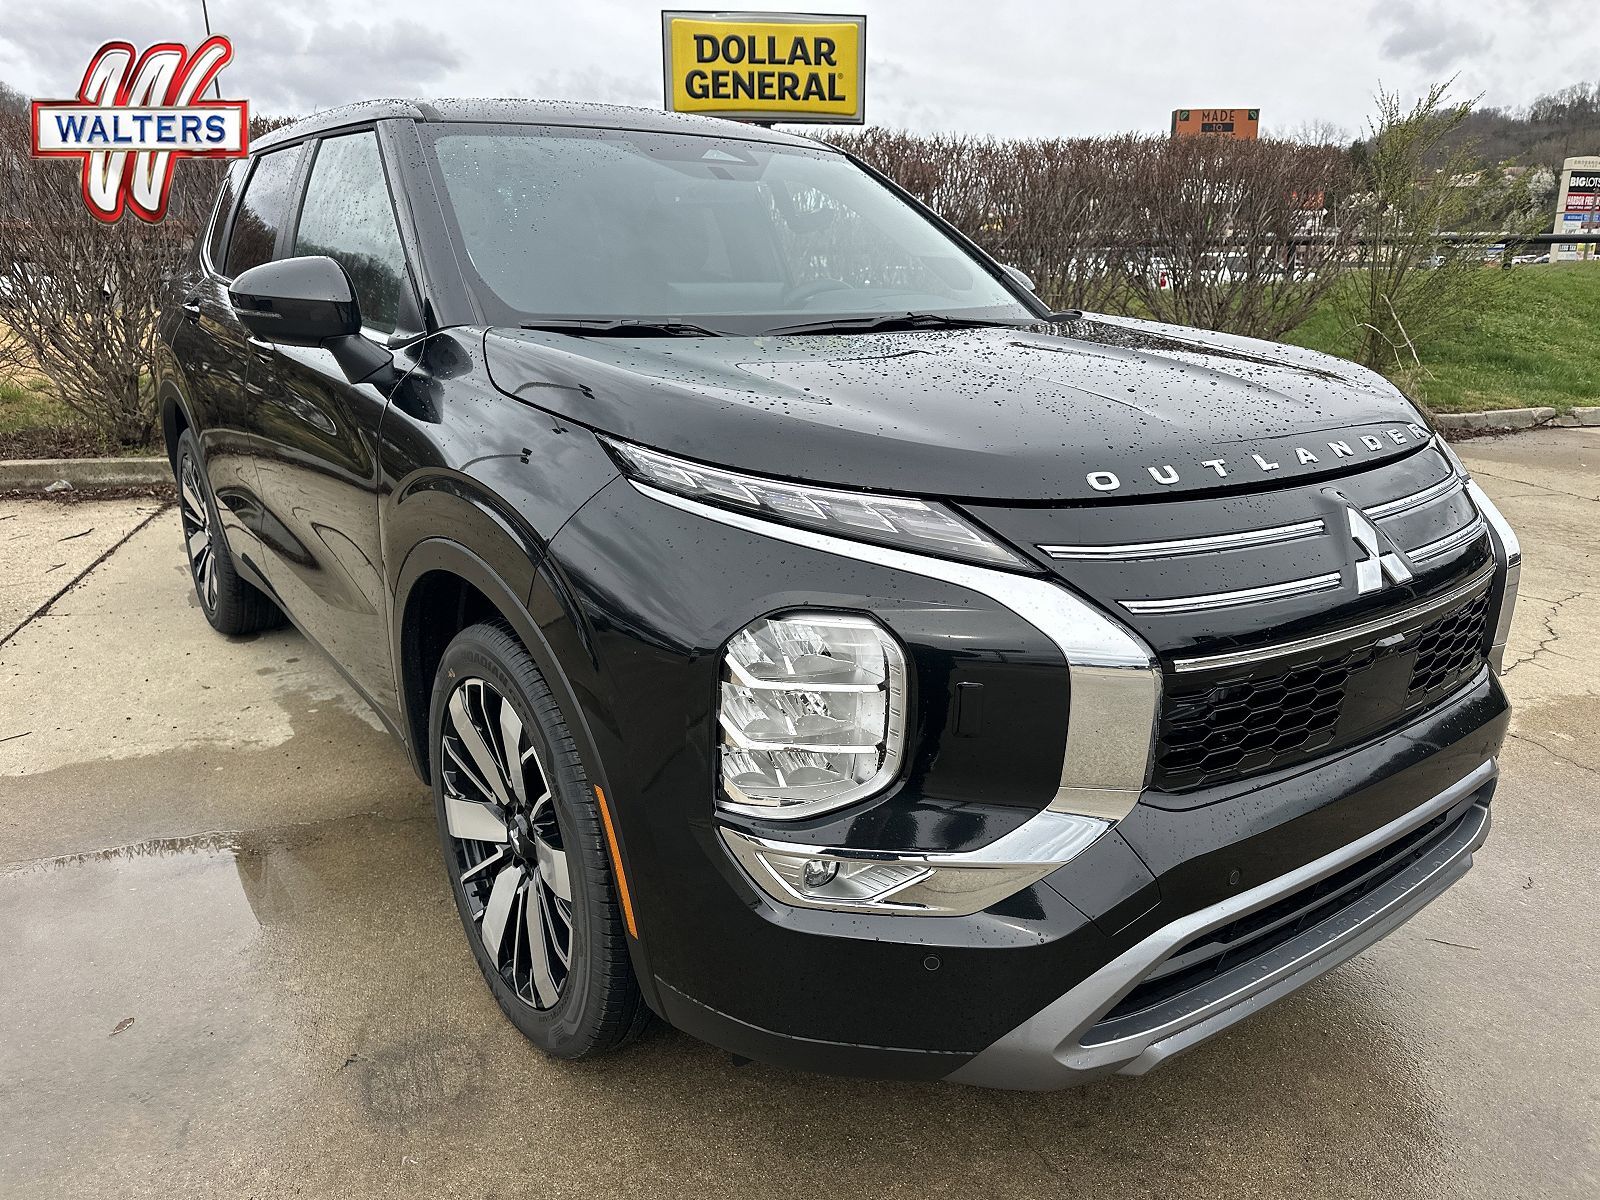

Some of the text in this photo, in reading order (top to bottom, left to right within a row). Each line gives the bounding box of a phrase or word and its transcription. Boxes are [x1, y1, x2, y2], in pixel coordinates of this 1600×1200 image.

[693, 33, 837, 67] DOLLAR
[685, 69, 846, 102] GENERAL
[1202, 110, 1235, 122] MADE
[1085, 423, 1427, 492] OUTLANDER
